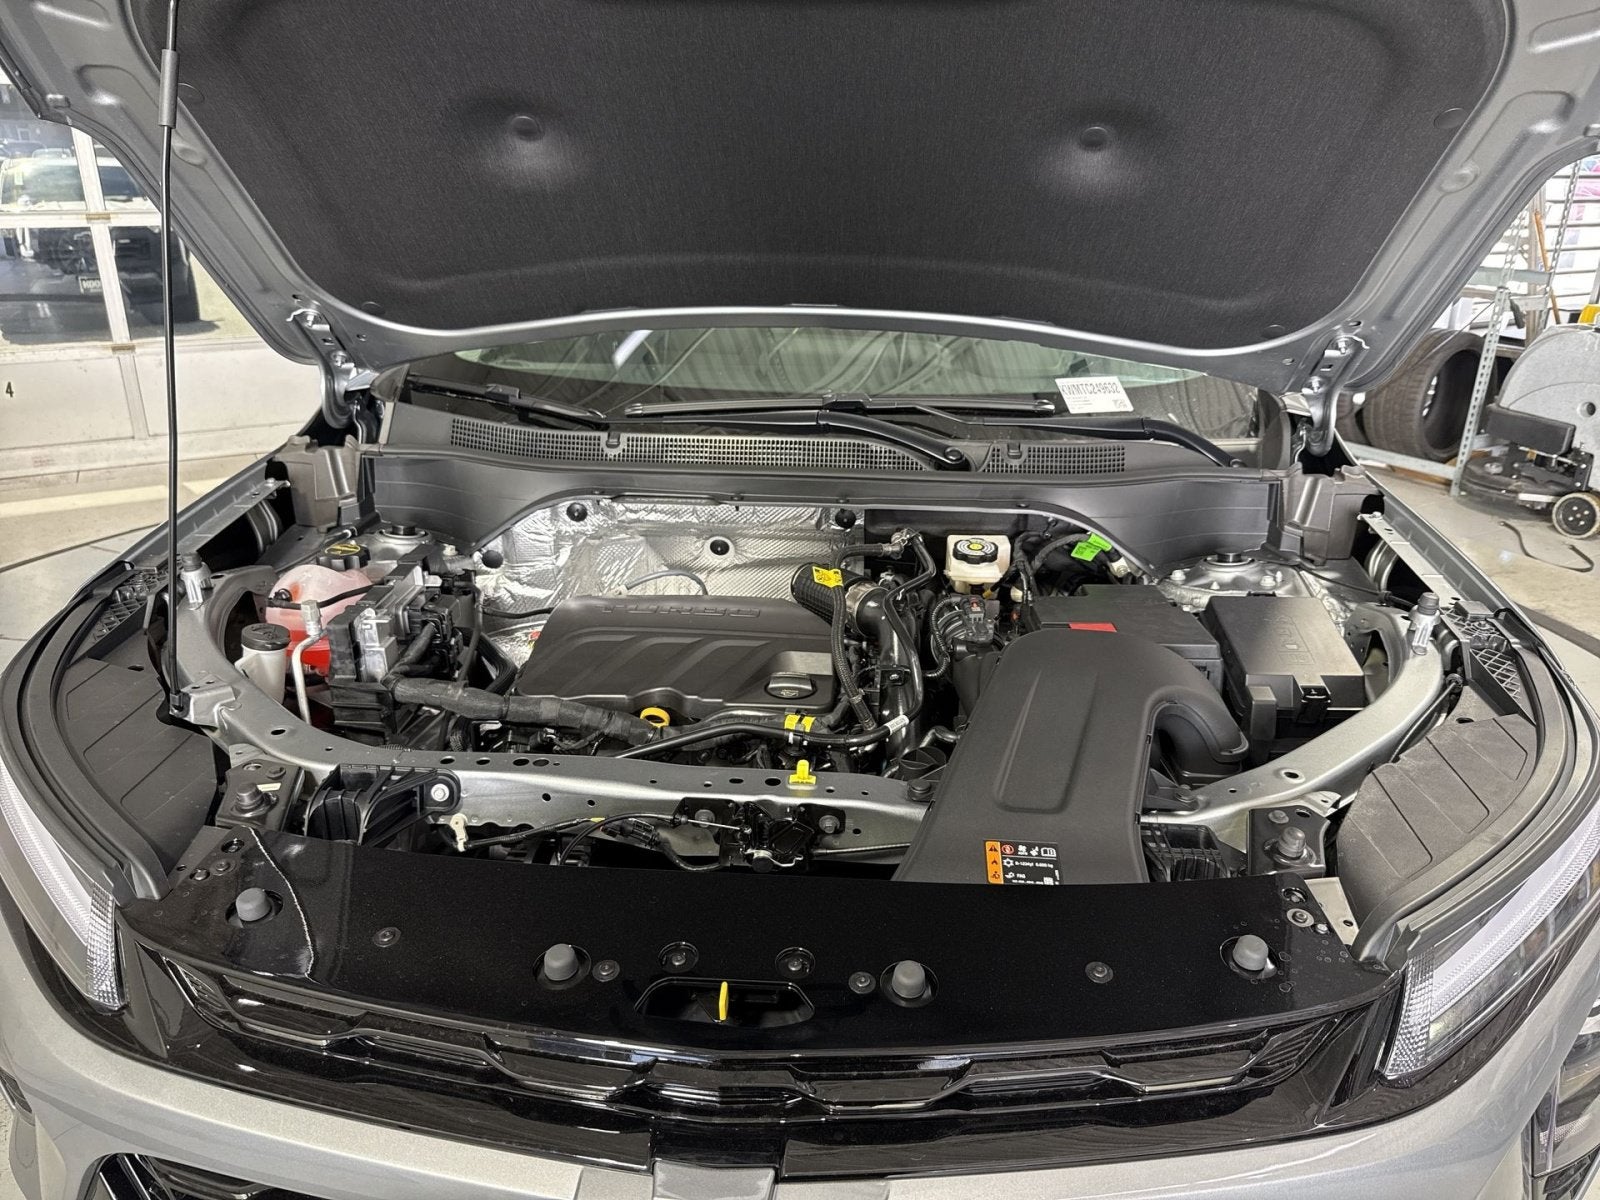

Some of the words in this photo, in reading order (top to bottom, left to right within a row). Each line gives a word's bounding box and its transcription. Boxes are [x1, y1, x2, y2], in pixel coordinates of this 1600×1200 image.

[82, 279, 101, 289] KOO
[5, 381, 14, 398] 4
[599, 603, 761, 617] TURBO
